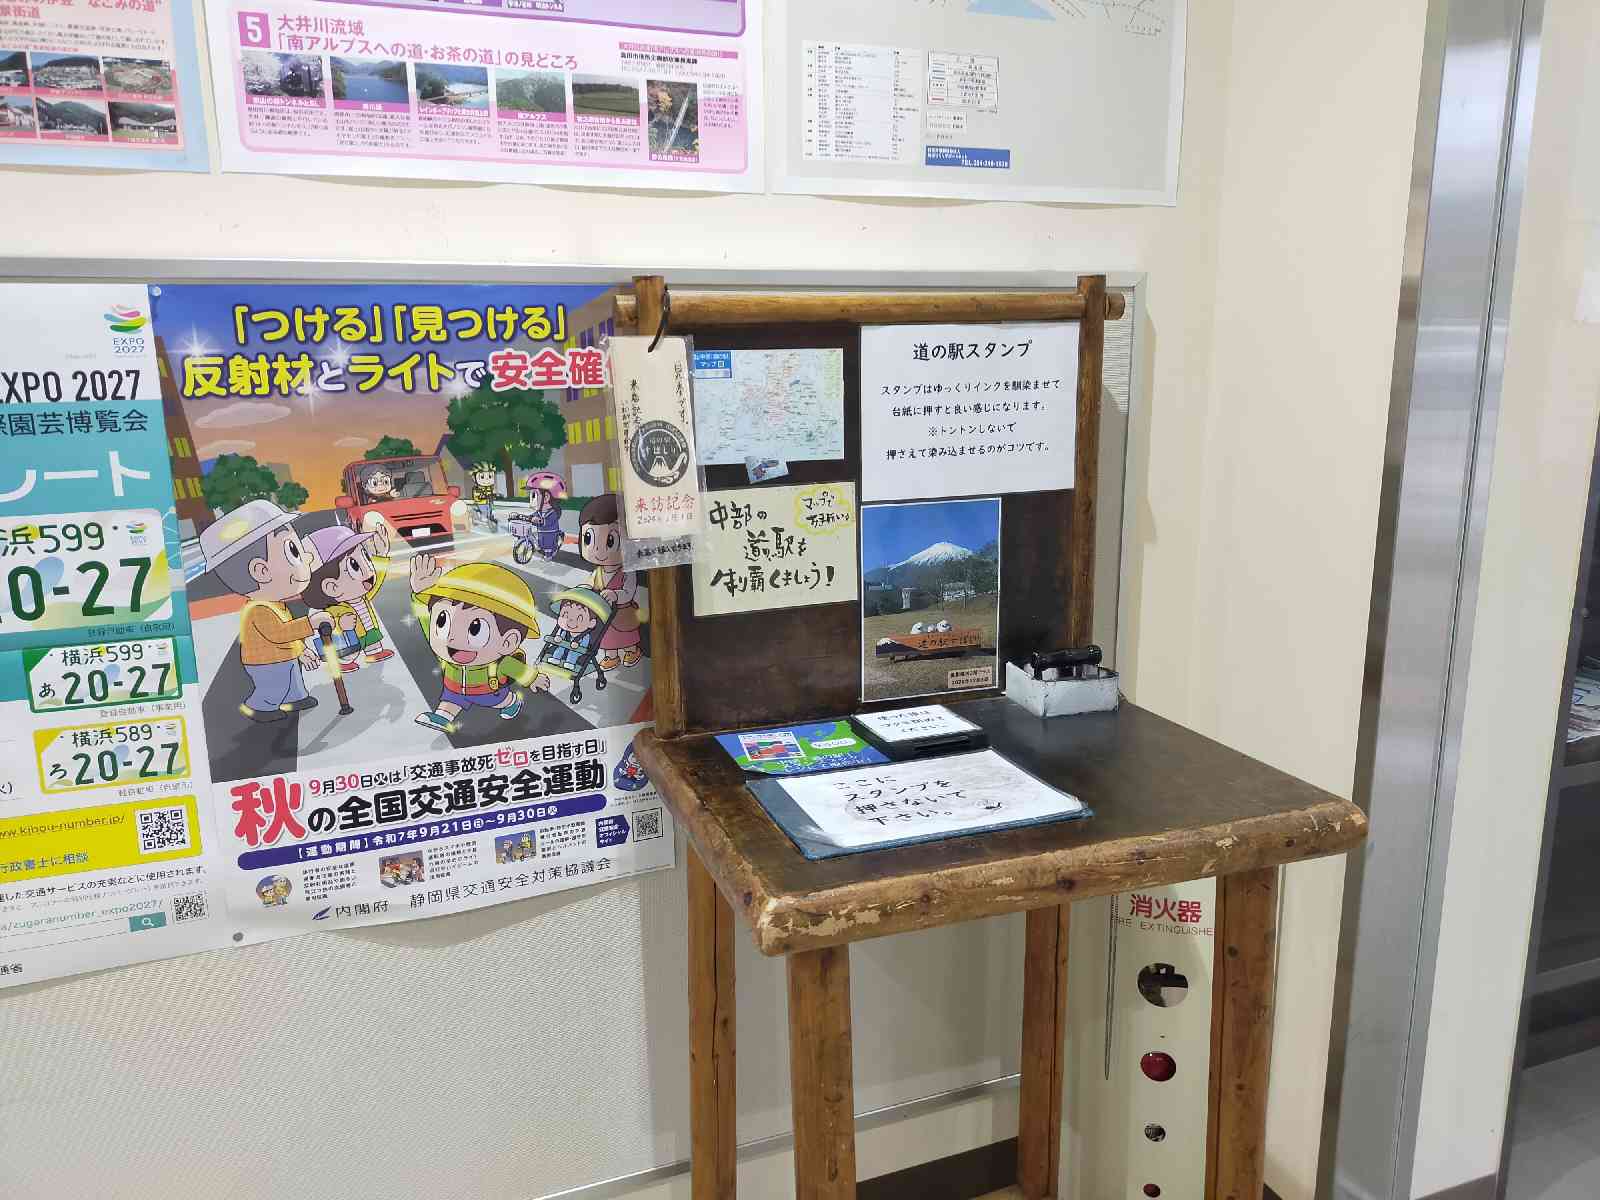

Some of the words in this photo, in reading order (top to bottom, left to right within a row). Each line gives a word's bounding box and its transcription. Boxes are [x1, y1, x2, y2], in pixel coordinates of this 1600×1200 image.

[246, 16, 263, 43] 5
[277, 14, 365, 36] 大井川流域
[113, 338, 145, 346] EXPO
[113, 346, 145, 354] 2027
[912, 337, 1033, 362] 道の駅スタンプ
[183, 348, 610, 398] 反射材とライトで安全確
[0, 371, 63, 404] XPO
[72, 369, 141, 402] 2027
[881, 379, 1061, 396] スタンプはゆっくりインクを馴染ませて
[892, 400, 1047, 417] 台紙に押すと良い感じになります。
[0, 409, 149, 437] 園芸博覧会
[886, 442, 1049, 460] 押さえて染み込ませるのがコツです。
[709, 501, 767, 531] 中部の
[38, 682, 56, 699] あ
[62, 662, 172, 705] 20-27
[49, 763, 68, 780] ろ
[72, 742, 180, 784] 20-27
[833, 776, 896, 789] ここに
[845, 780, 952, 802] スタンプを
[307, 758, 606, 833] の全国交通安全運動
[855, 790, 967, 815] 押さないで
[230, 776, 307, 848] 秋
[868, 809, 952, 826] 下さい。
[335, 899, 389, 918] 内閣府
[410, 857, 612, 909] 静岡県交通安全対策協議会
[1130, 894, 1201, 923] 消火器
[1140, 920, 1214, 936] EXTINGUISHE
